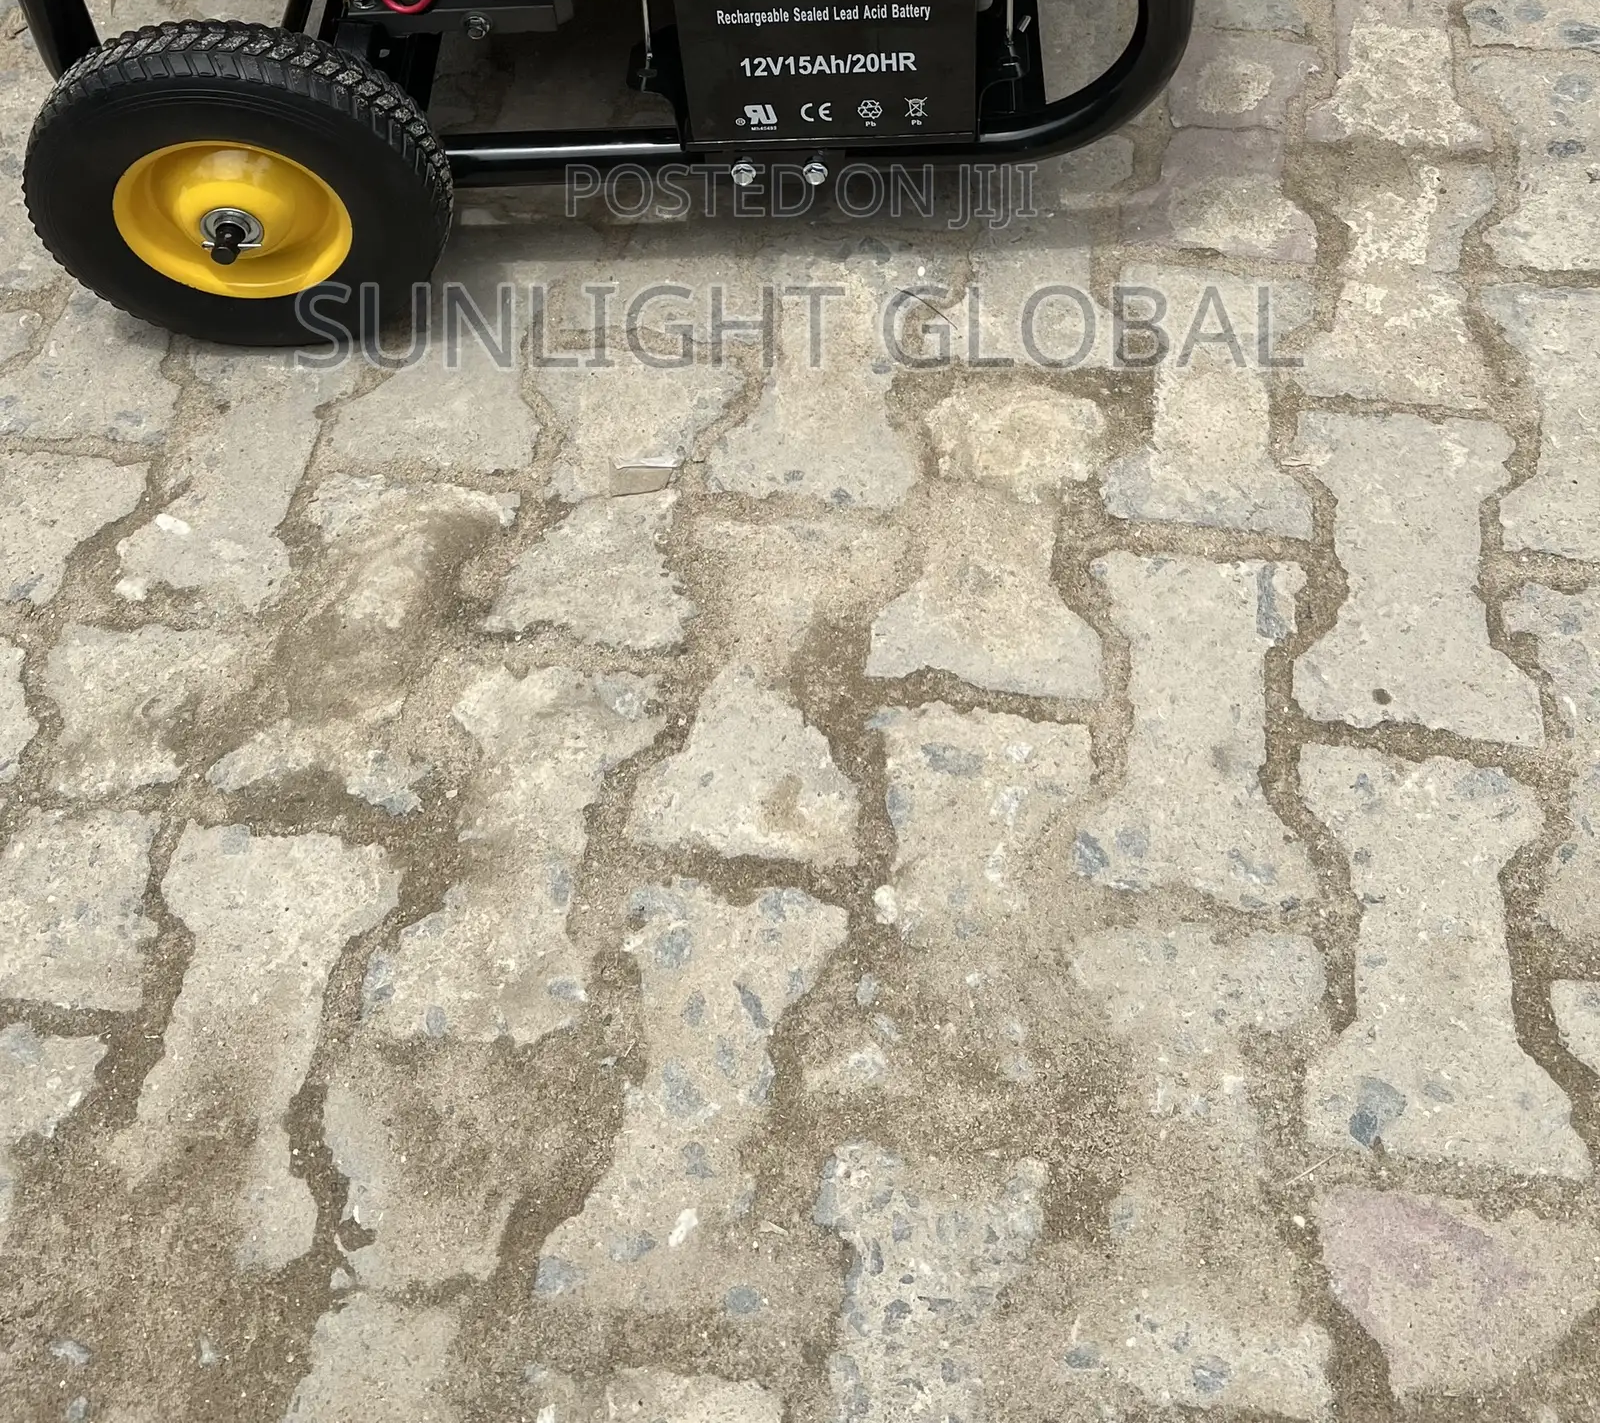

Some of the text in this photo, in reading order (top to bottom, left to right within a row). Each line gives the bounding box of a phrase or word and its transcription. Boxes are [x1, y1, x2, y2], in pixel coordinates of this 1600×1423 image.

[716, 3, 931, 26] Rechargeable Sealed Lead Acid Battery
[740, 52, 917, 77] 12V15Ah/20HR
